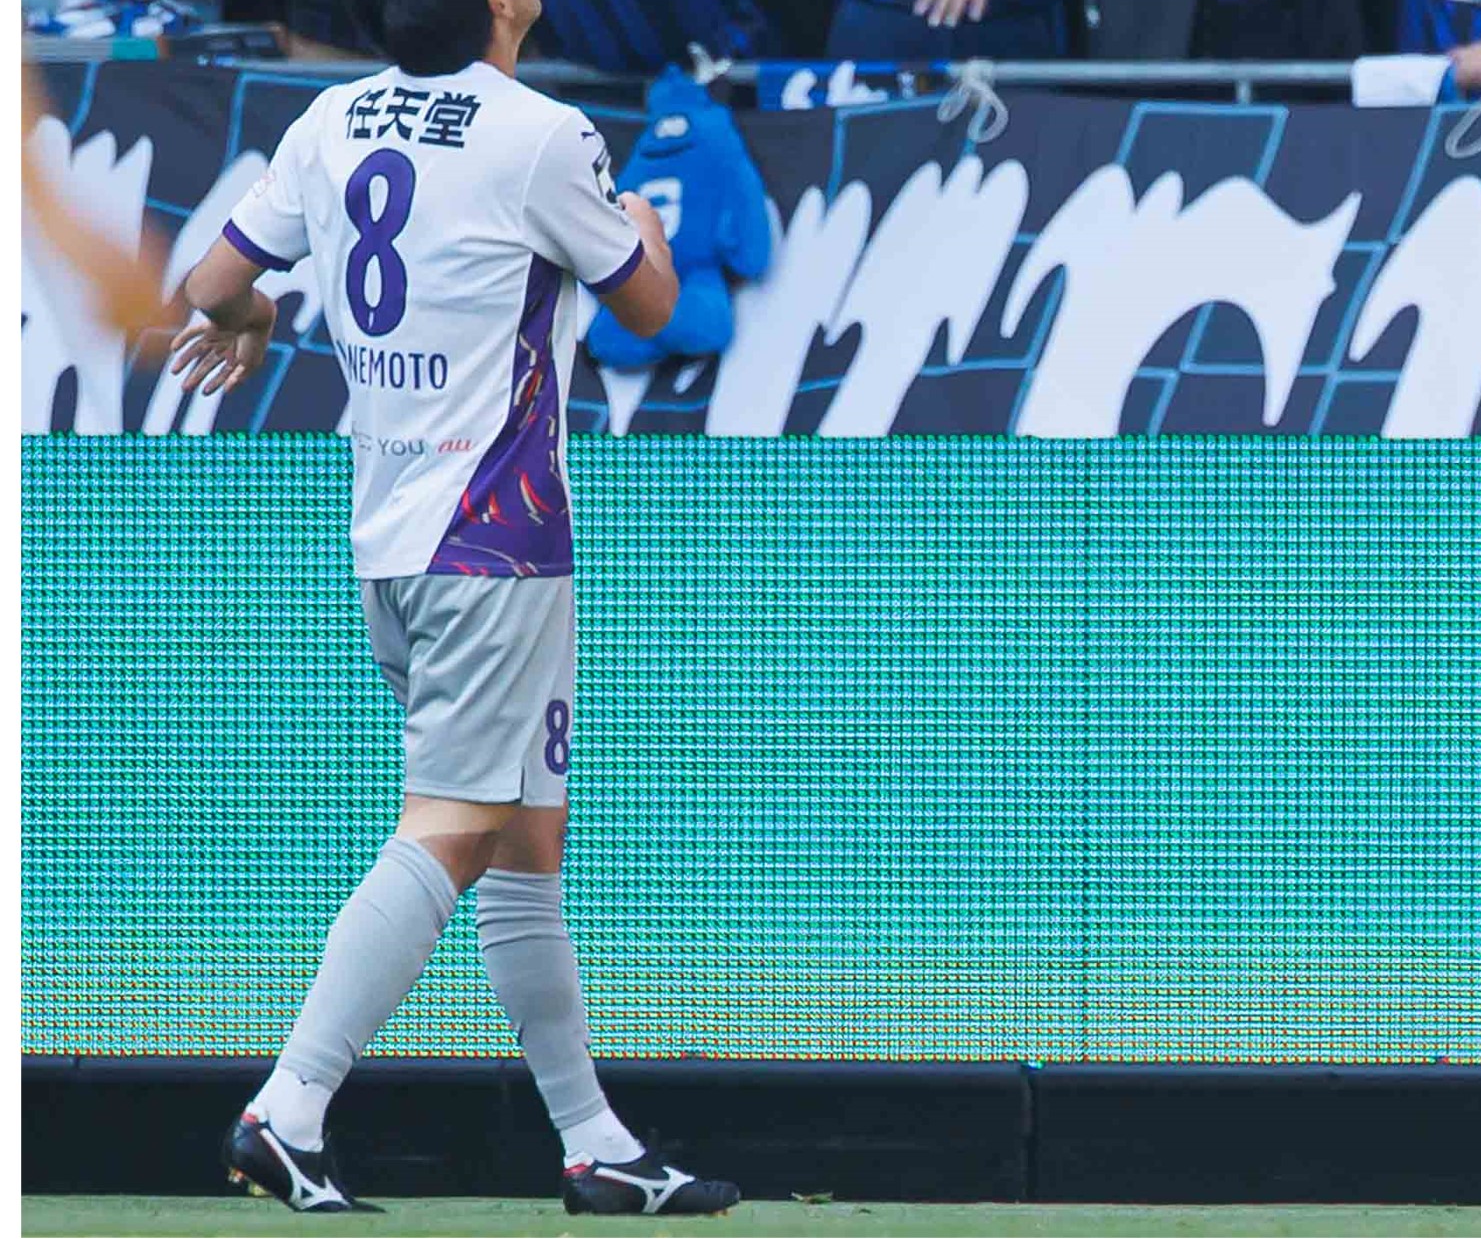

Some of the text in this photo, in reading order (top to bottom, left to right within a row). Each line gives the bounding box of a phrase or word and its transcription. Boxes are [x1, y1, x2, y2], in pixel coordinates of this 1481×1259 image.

[345, 86, 482, 148] 任天堂
[344, 147, 417, 338] 8
[544, 697, 571, 777] 8
